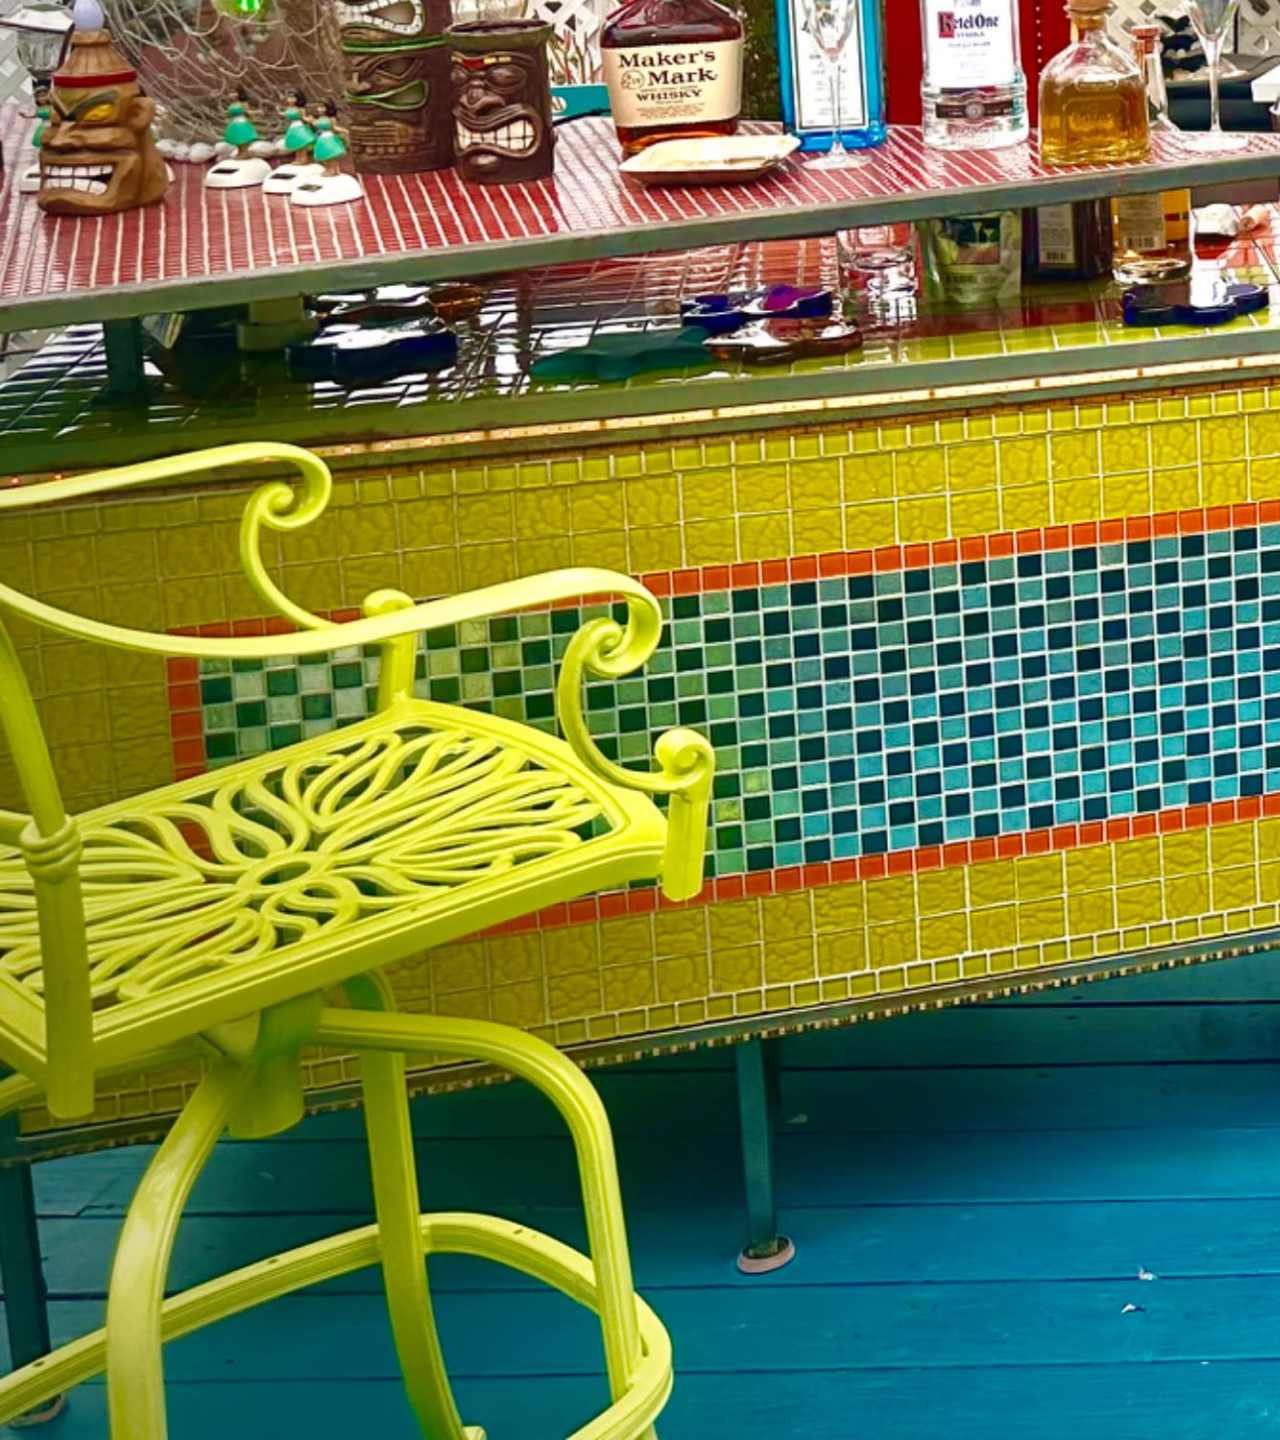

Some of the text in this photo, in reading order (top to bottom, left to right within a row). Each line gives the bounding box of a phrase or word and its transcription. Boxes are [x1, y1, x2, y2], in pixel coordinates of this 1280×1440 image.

[618, 49, 717, 68] Maker's
[648, 68, 718, 86] Mark
[636, 89, 702, 101] WHISKY
